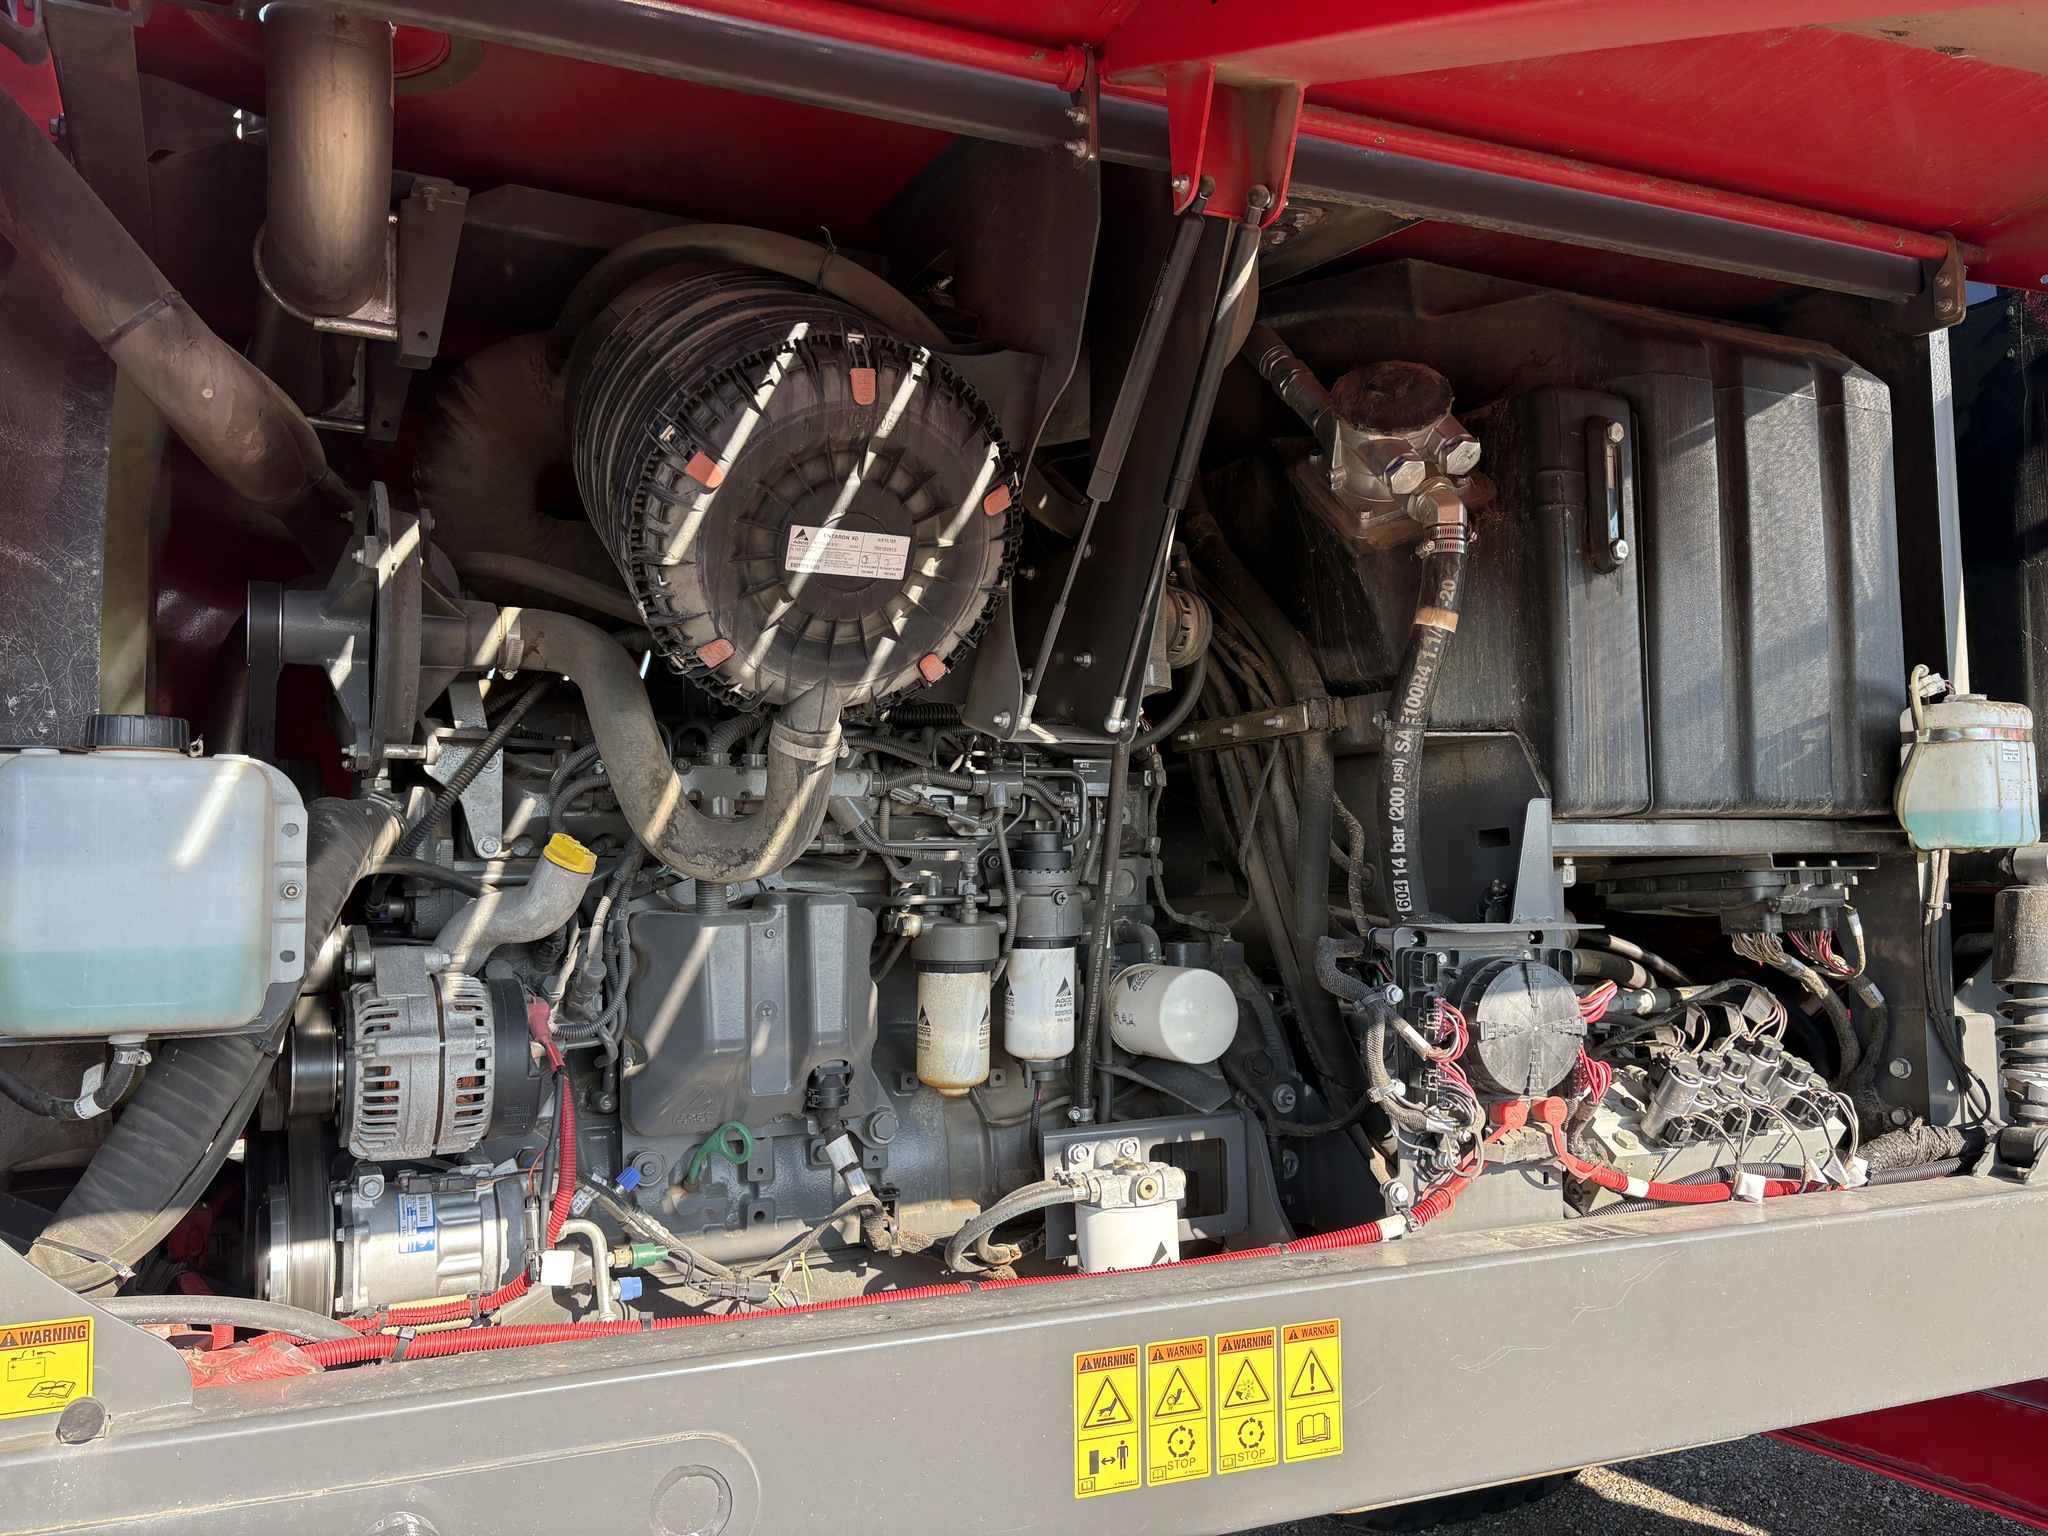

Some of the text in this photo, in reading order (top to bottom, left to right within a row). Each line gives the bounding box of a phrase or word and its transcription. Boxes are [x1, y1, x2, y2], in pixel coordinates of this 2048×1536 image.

[1392, 758, 1408, 783] psi)
[1389, 786, 1406, 821] (200
[1390, 826, 1406, 853] bar
[1391, 857, 1407, 877] 14
[1395, 881, 1411, 909] 604
[20, 1325, 87, 1345] WARNING
[1301, 1324, 1335, 1338] WARNING
[1167, 1343, 1203, 1358] WARNING
[1233, 1334, 1272, 1350] WARNING
[1093, 1352, 1135, 1369] WARNING
[1167, 1457, 1197, 1471] STOP
[1238, 1449, 1266, 1462] STOP
